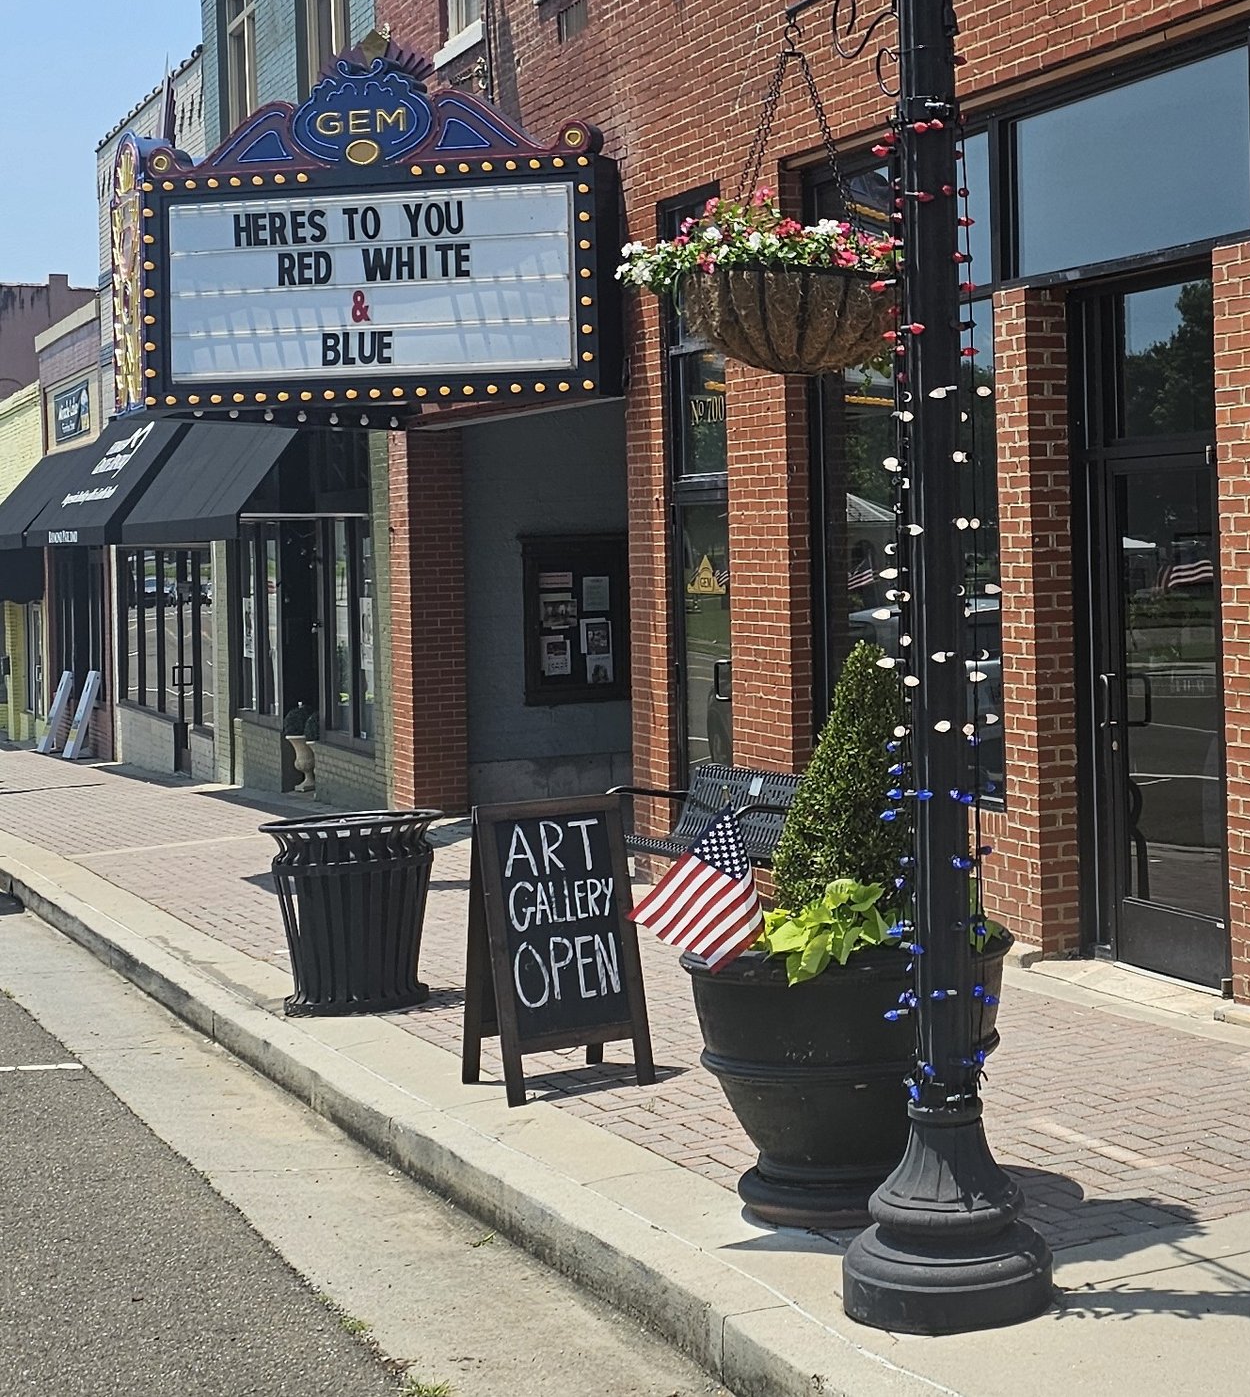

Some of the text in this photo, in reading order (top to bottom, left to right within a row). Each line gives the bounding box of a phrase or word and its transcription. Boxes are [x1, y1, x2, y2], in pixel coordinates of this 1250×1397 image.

[316, 107, 407, 135] GEM
[233, 200, 466, 248] HERES TO YOU
[278, 242, 471, 286] RED WHITE
[351, 290, 370, 323] &
[321, 330, 393, 367] BLUE
[706, 395, 725, 423] 700
[505, 817, 599, 878] ART
[508, 877, 614, 933] GALLERY
[513, 931, 622, 1009] OPEN
